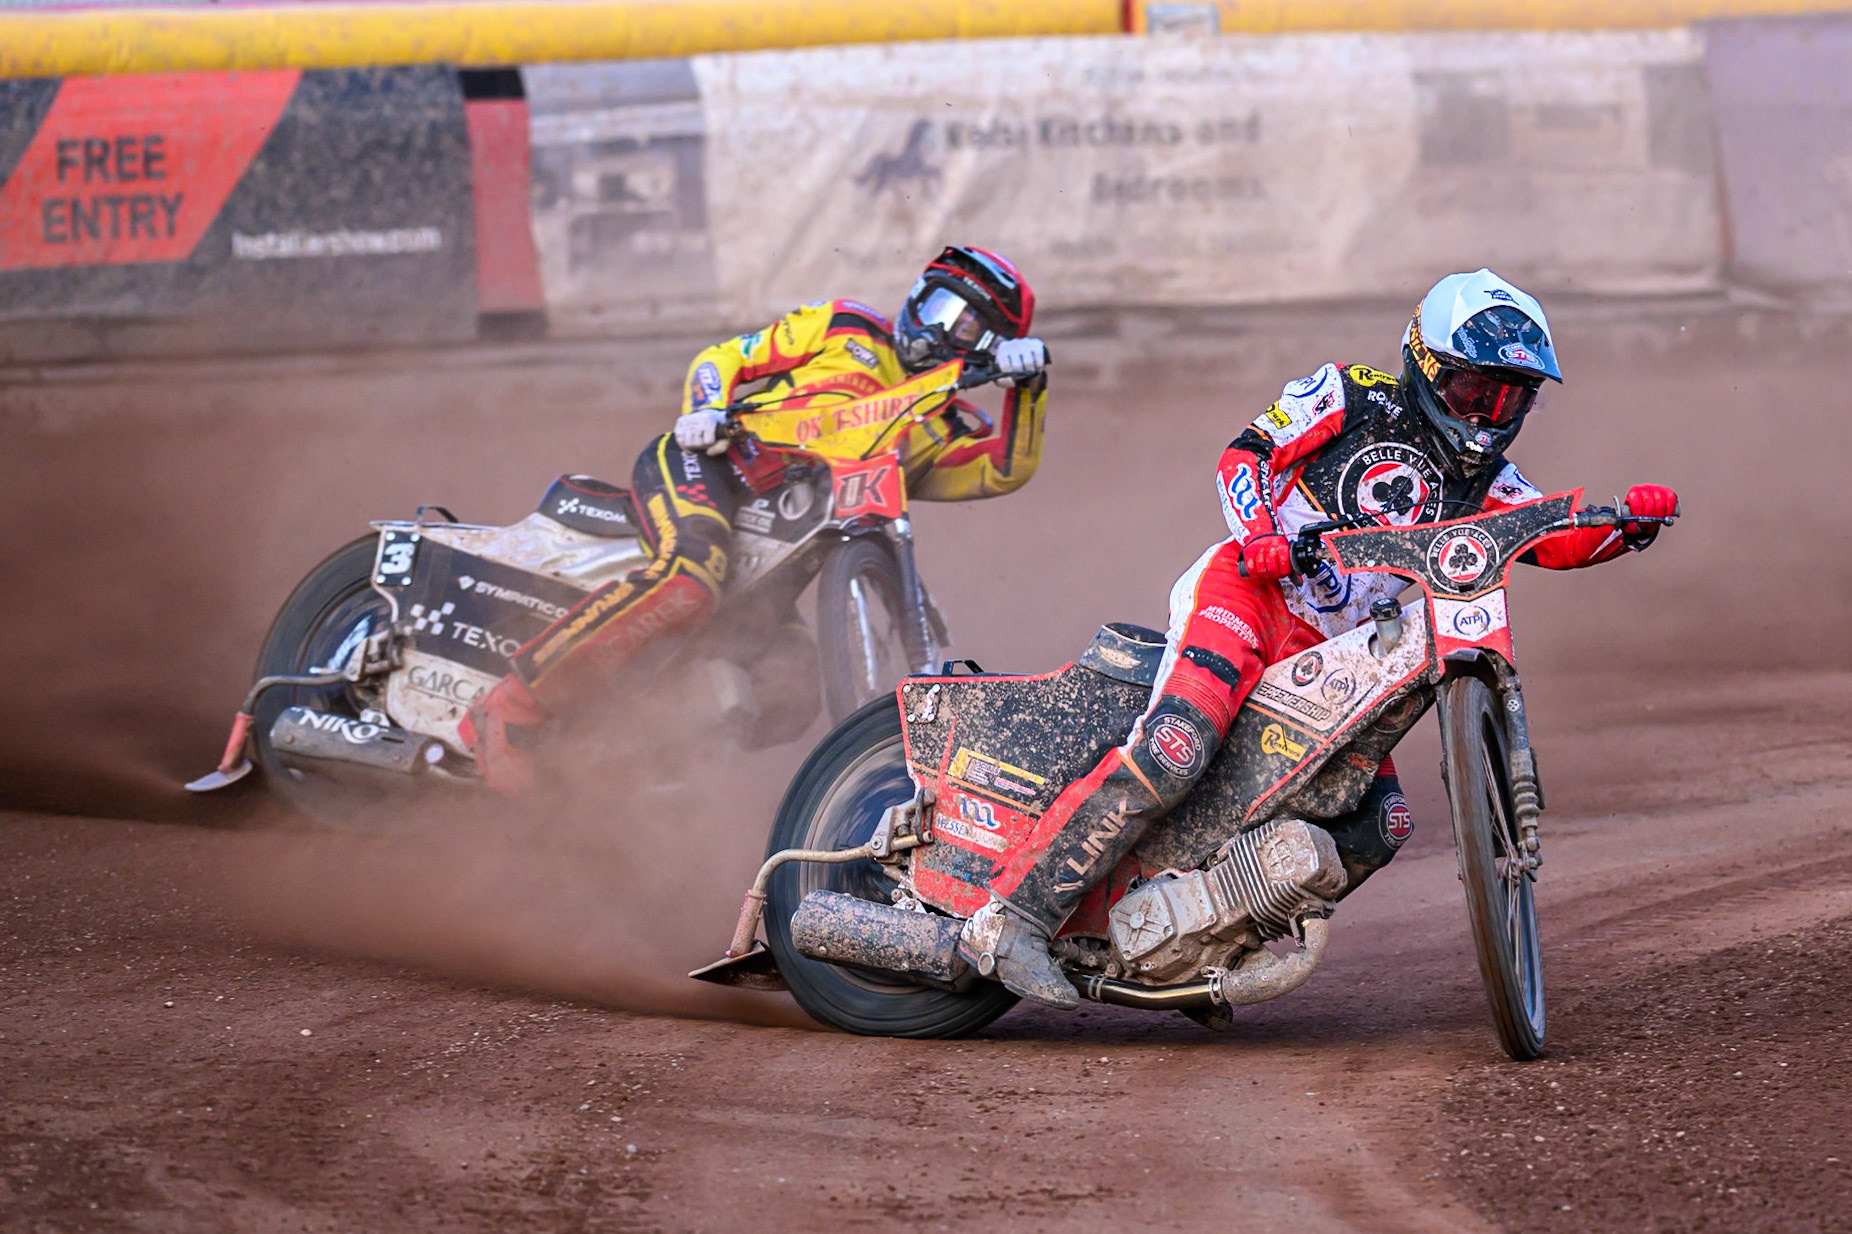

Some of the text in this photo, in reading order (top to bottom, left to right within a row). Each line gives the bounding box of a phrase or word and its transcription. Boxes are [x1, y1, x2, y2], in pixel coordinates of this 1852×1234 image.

[55, 134, 167, 185] FREE
[41, 192, 185, 244] ENTRY
[1367, 389, 1403, 416] ROWE
[1362, 450, 1440, 517] BELLE VUE ACES
[381, 542, 415, 575] 3
[1430, 533, 1450, 559] BELLE
[1451, 528, 1471, 537] VUE
[474, 580, 571, 619] SYMPATICO
[1460, 614, 1484, 627] ATPI
[1156, 726, 1194, 762] STS
[1163, 716, 1202, 751] STAKEFORD
[1158, 753, 1188, 775] SERVICES
[1066, 793, 1143, 876] LINK
[1388, 811, 1411, 829] STS
